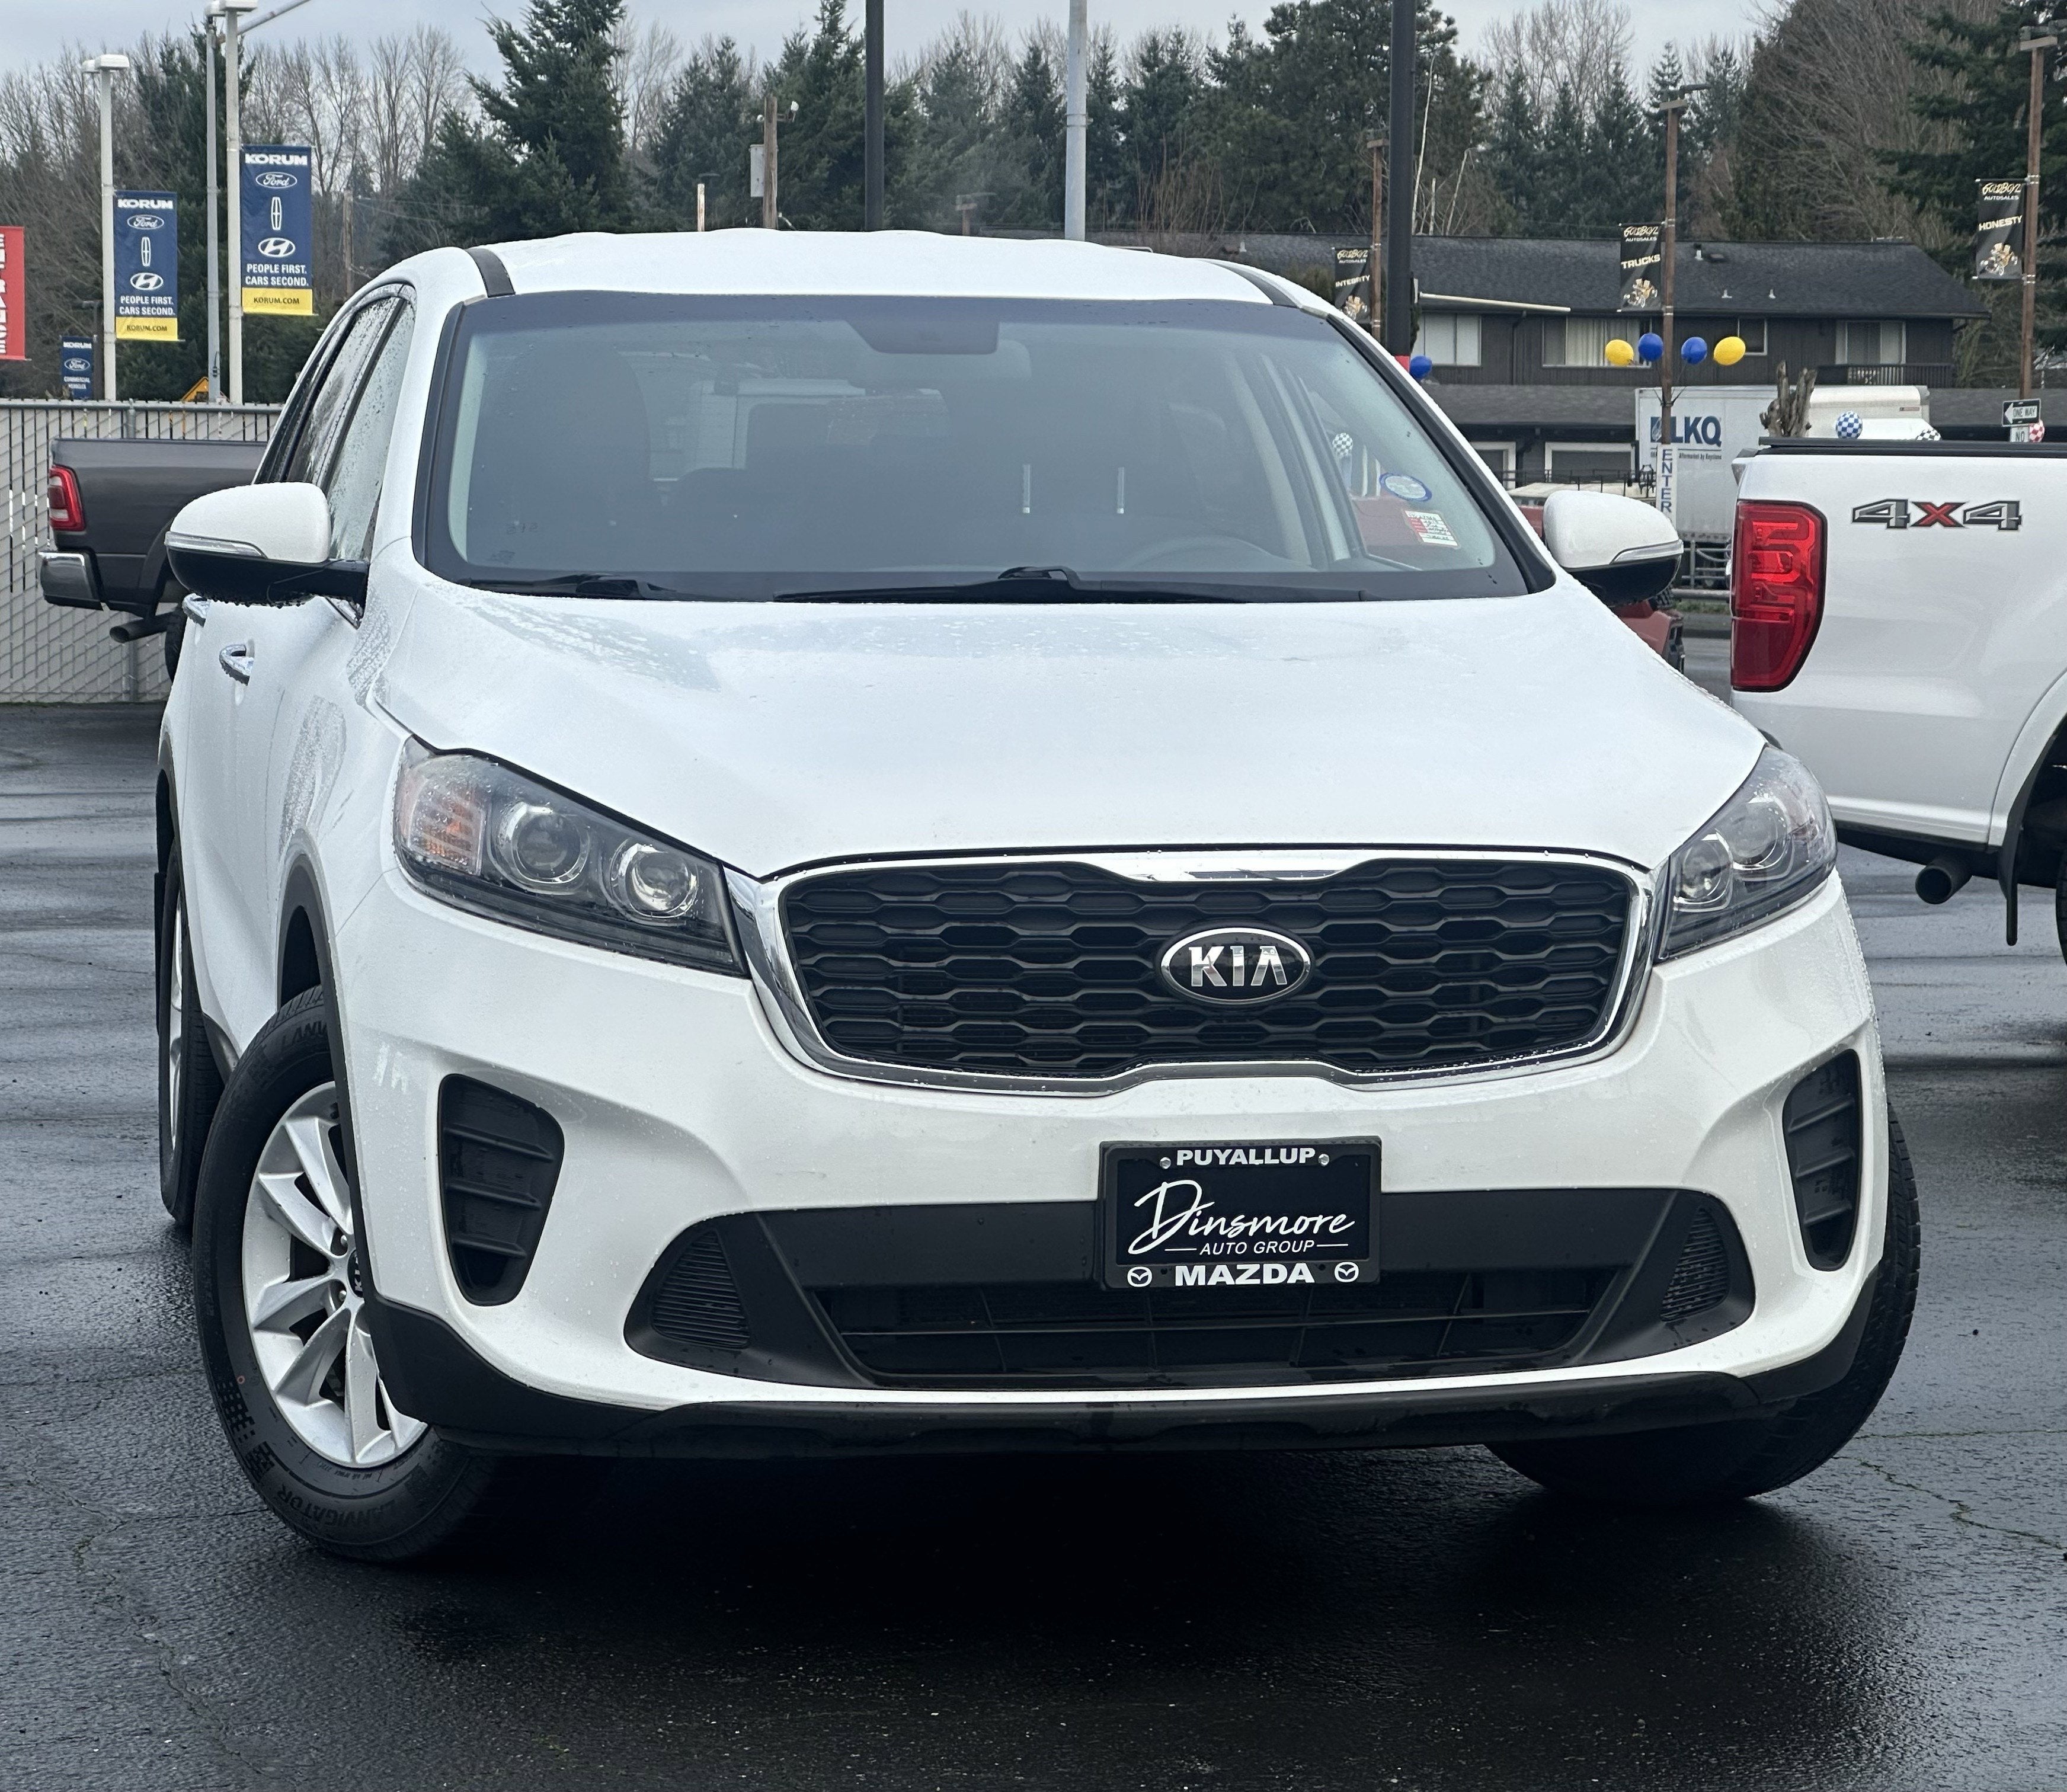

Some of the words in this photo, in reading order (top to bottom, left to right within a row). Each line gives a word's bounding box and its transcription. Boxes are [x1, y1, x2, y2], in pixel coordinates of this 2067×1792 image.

[245, 153, 308, 165] KORUM
[117, 199, 174, 209] KORUM
[1979, 215, 2023, 231] HONESTY
[1621, 254, 1660, 269] TRUCKS
[247, 263, 280, 274] PEOPLE
[281, 264, 307, 274] FIRST.
[245, 276, 268, 286] CARS
[271, 276, 309, 287] SECOND.
[1335, 275, 1370, 287] INTEGRITY
[120, 295, 149, 305] PEOPLE
[151, 296, 174, 305] FIRST.
[253, 296, 300, 305] KORUM.COM
[119, 306, 140, 315] CARS
[142, 306, 175, 316] SECOND.
[127, 324, 168, 332] KORUM.COM
[2013, 408, 2023, 418] ONE
[2025, 407, 2036, 417] WAY
[1670, 415, 1722, 447] LKQ
[2015, 431, 2025, 441] NO
[1660, 449, 1673, 513] ENTER
[1188, 945, 1288, 987] KIA
[1176, 1147, 1316, 1166] PUYALLUP
[1128, 1179, 1355, 1255] Dinsmore
[1199, 1241, 1246, 1256] AUTO
[1253, 1240, 1316, 1255] GROUP
[1175, 1263, 1315, 1287] MAZDA
